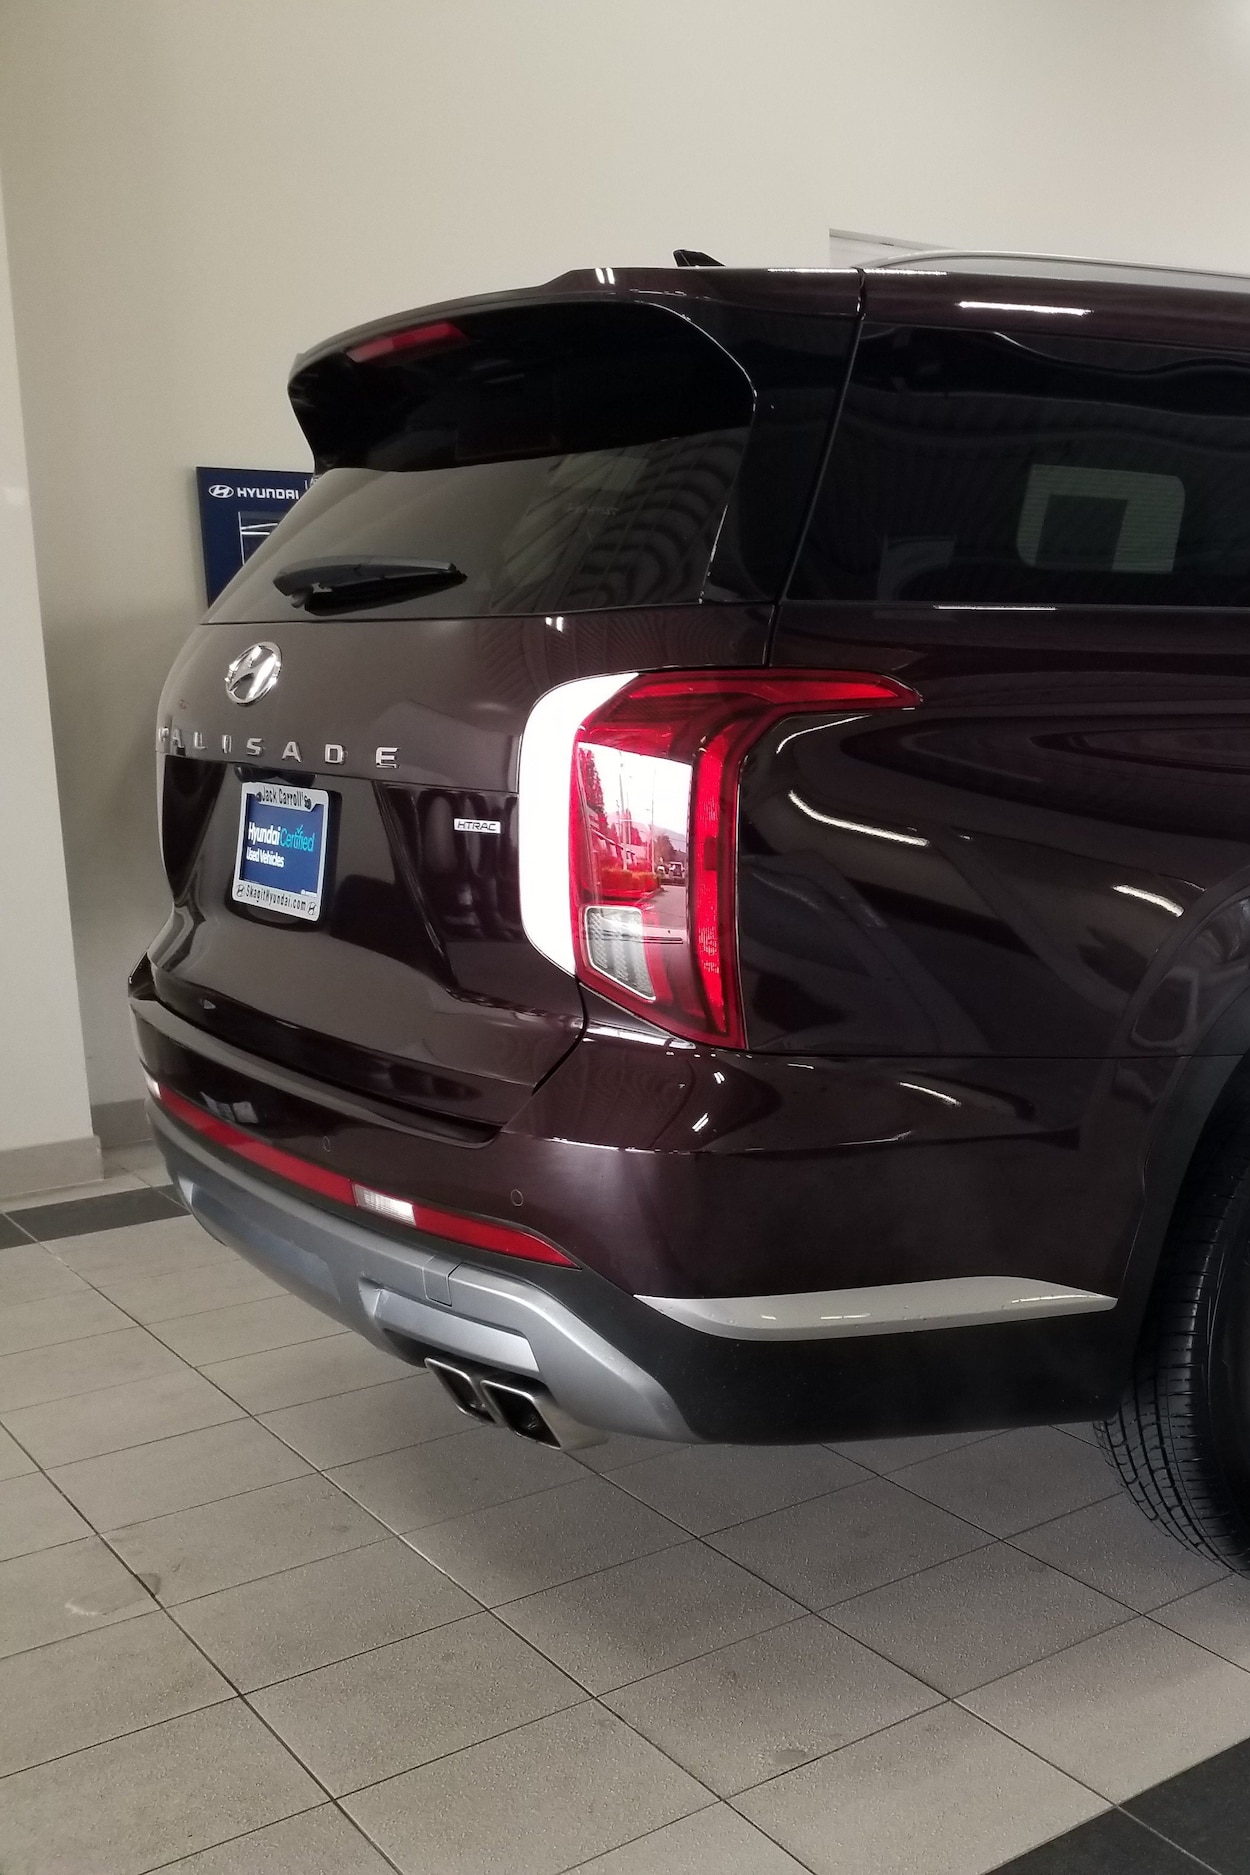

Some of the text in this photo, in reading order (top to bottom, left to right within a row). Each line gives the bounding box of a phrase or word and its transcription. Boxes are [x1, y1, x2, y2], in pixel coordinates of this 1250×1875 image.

[237, 487, 300, 500] HYUNDAI
[158, 726, 399, 769] PALISADE
[261, 786, 277, 804] Jack
[457, 820, 497, 831] HTRAC
[248, 822, 315, 852] Hyundai Certified
[246, 847, 285, 868] Used Vehicles
[245, 884, 307, 911] SkagitHyundai.com
